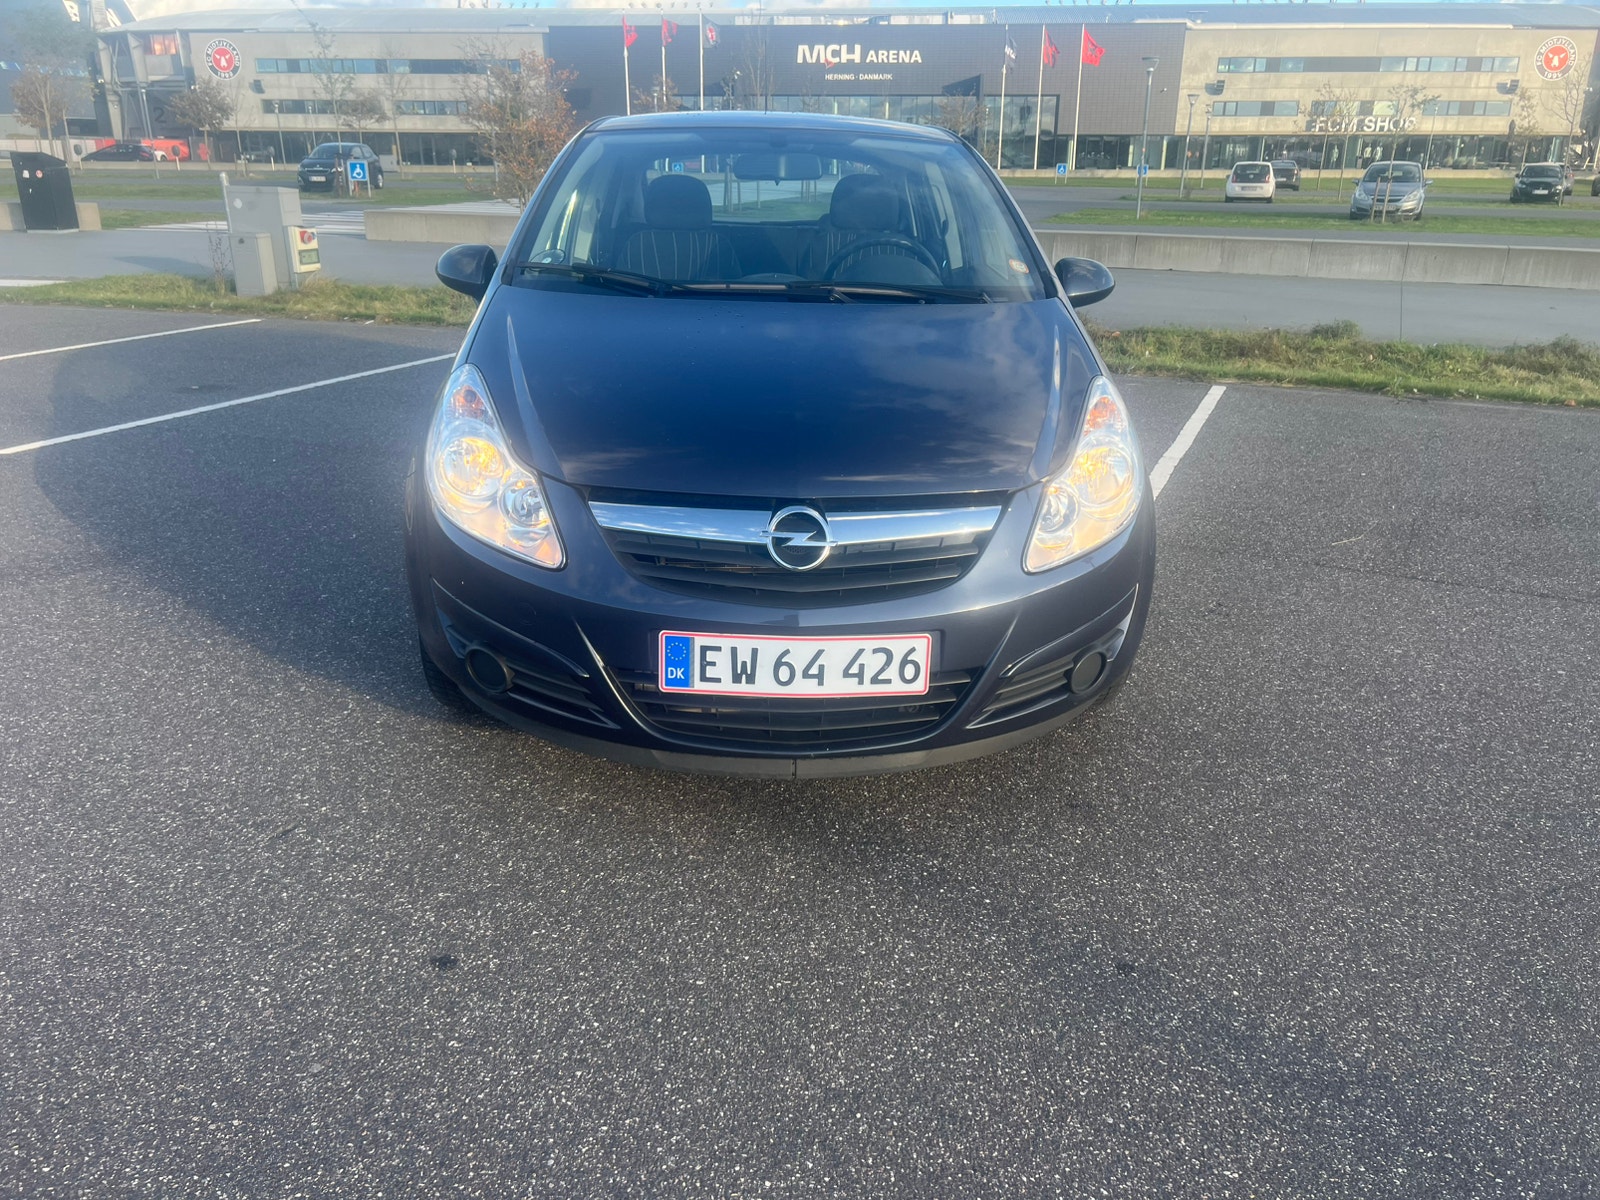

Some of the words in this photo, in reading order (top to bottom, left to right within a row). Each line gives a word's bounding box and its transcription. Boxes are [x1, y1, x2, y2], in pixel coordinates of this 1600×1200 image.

[797, 44, 861, 64] MCH
[866, 50, 922, 64] ARENA
[1539, 38, 1576, 66] MIDTJYLLAND
[825, 73, 855, 81] HERNING
[859, 73, 893, 81] DANMARK
[1363, 116, 1417, 133] SHOP
[667, 667, 685, 680] DK
[699, 645, 759, 685] EW
[772, 648, 826, 687] 64
[842, 646, 922, 686] 426
